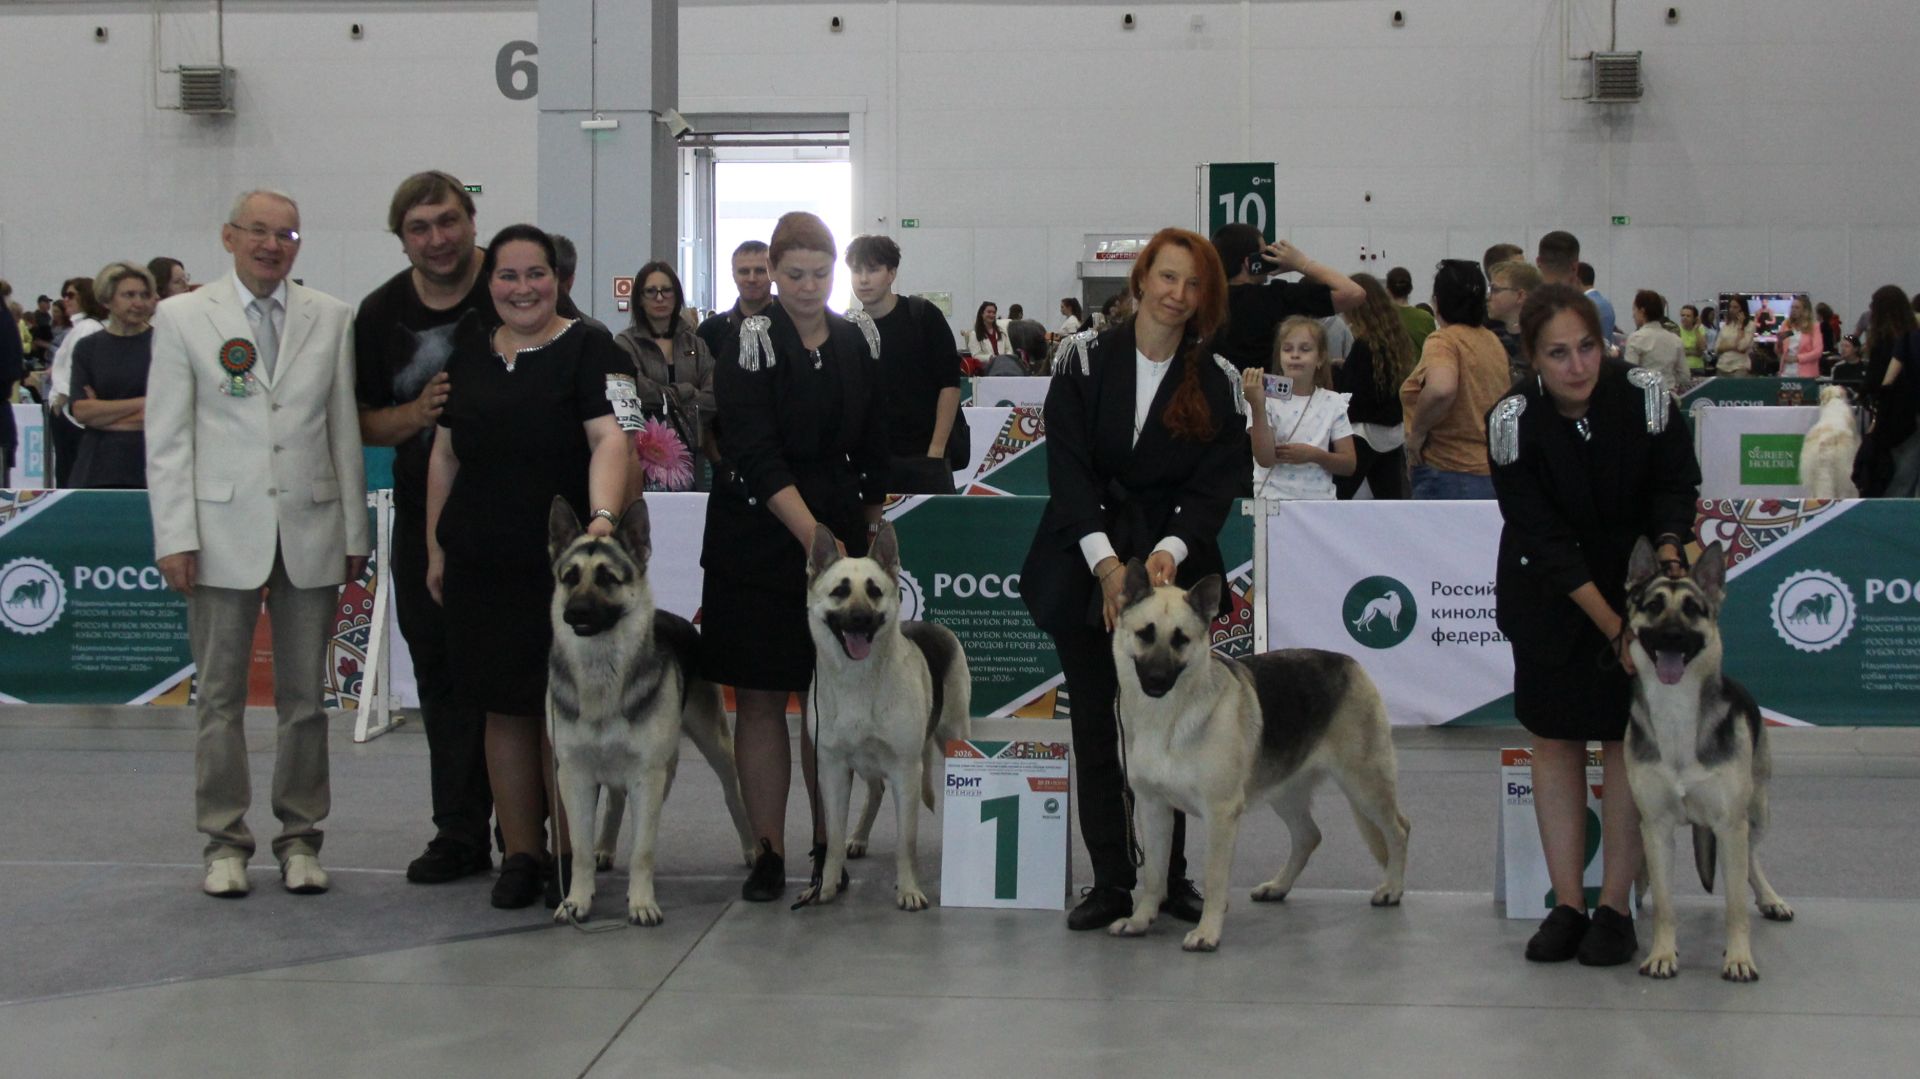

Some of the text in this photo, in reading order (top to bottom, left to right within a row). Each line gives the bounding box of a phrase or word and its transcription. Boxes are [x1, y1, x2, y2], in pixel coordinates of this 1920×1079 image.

[496, 40, 538, 100] 6
[1219, 192, 1266, 234] 10
[1757, 450, 1793, 459] GREEN
[1749, 460, 1794, 468] HOLDER
[1002, 632, 1040, 640] МОСКВЫ
[946, 774, 982, 789] Брит
[980, 794, 1020, 900] 1
